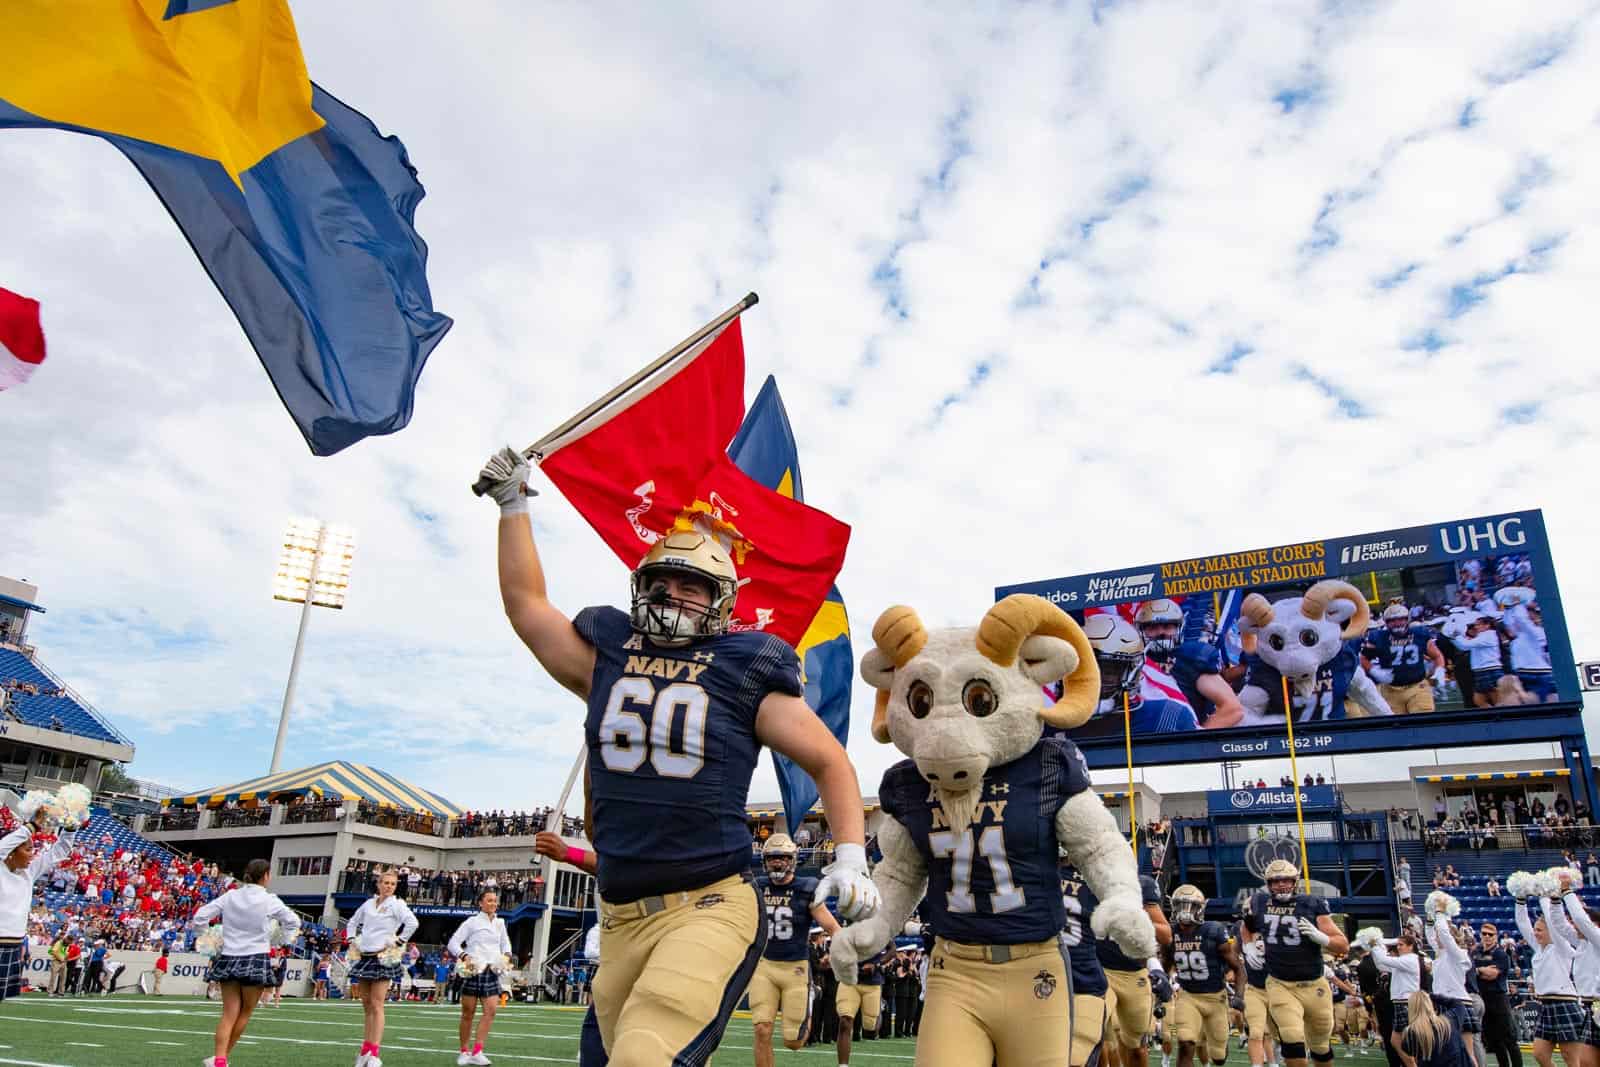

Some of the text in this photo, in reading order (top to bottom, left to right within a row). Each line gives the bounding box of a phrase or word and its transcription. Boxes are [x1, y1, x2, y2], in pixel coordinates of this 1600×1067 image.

[1440, 517, 1526, 554] UHG
[1361, 540, 1396, 553] FIRST
[1361, 546, 1425, 561] COMMAND
[1161, 543, 1325, 579] NAVY-MARINE CORPS
[1088, 576, 1127, 592] Navy
[1164, 560, 1327, 596] MEMORIAL STADIUM
[1046, 590, 1078, 603] idos
[1099, 583, 1153, 601] Mutual
[624, 655, 708, 682] NAVY
[599, 677, 709, 779] 60
[1222, 743, 1254, 753] Class
[1255, 741, 1268, 751] of
[1314, 736, 1332, 747] HP
[931, 800, 1008, 829] NVY
[928, 825, 1026, 914] 71
[1060, 880, 1081, 896] VY
[764, 896, 792, 906] NAVY
[1267, 907, 1295, 915] NAVY
[1263, 914, 1301, 946] 73
[1175, 942, 1202, 951] NAVY
[172, 965, 209, 977] SOUT
[1174, 951, 1209, 981] 29
